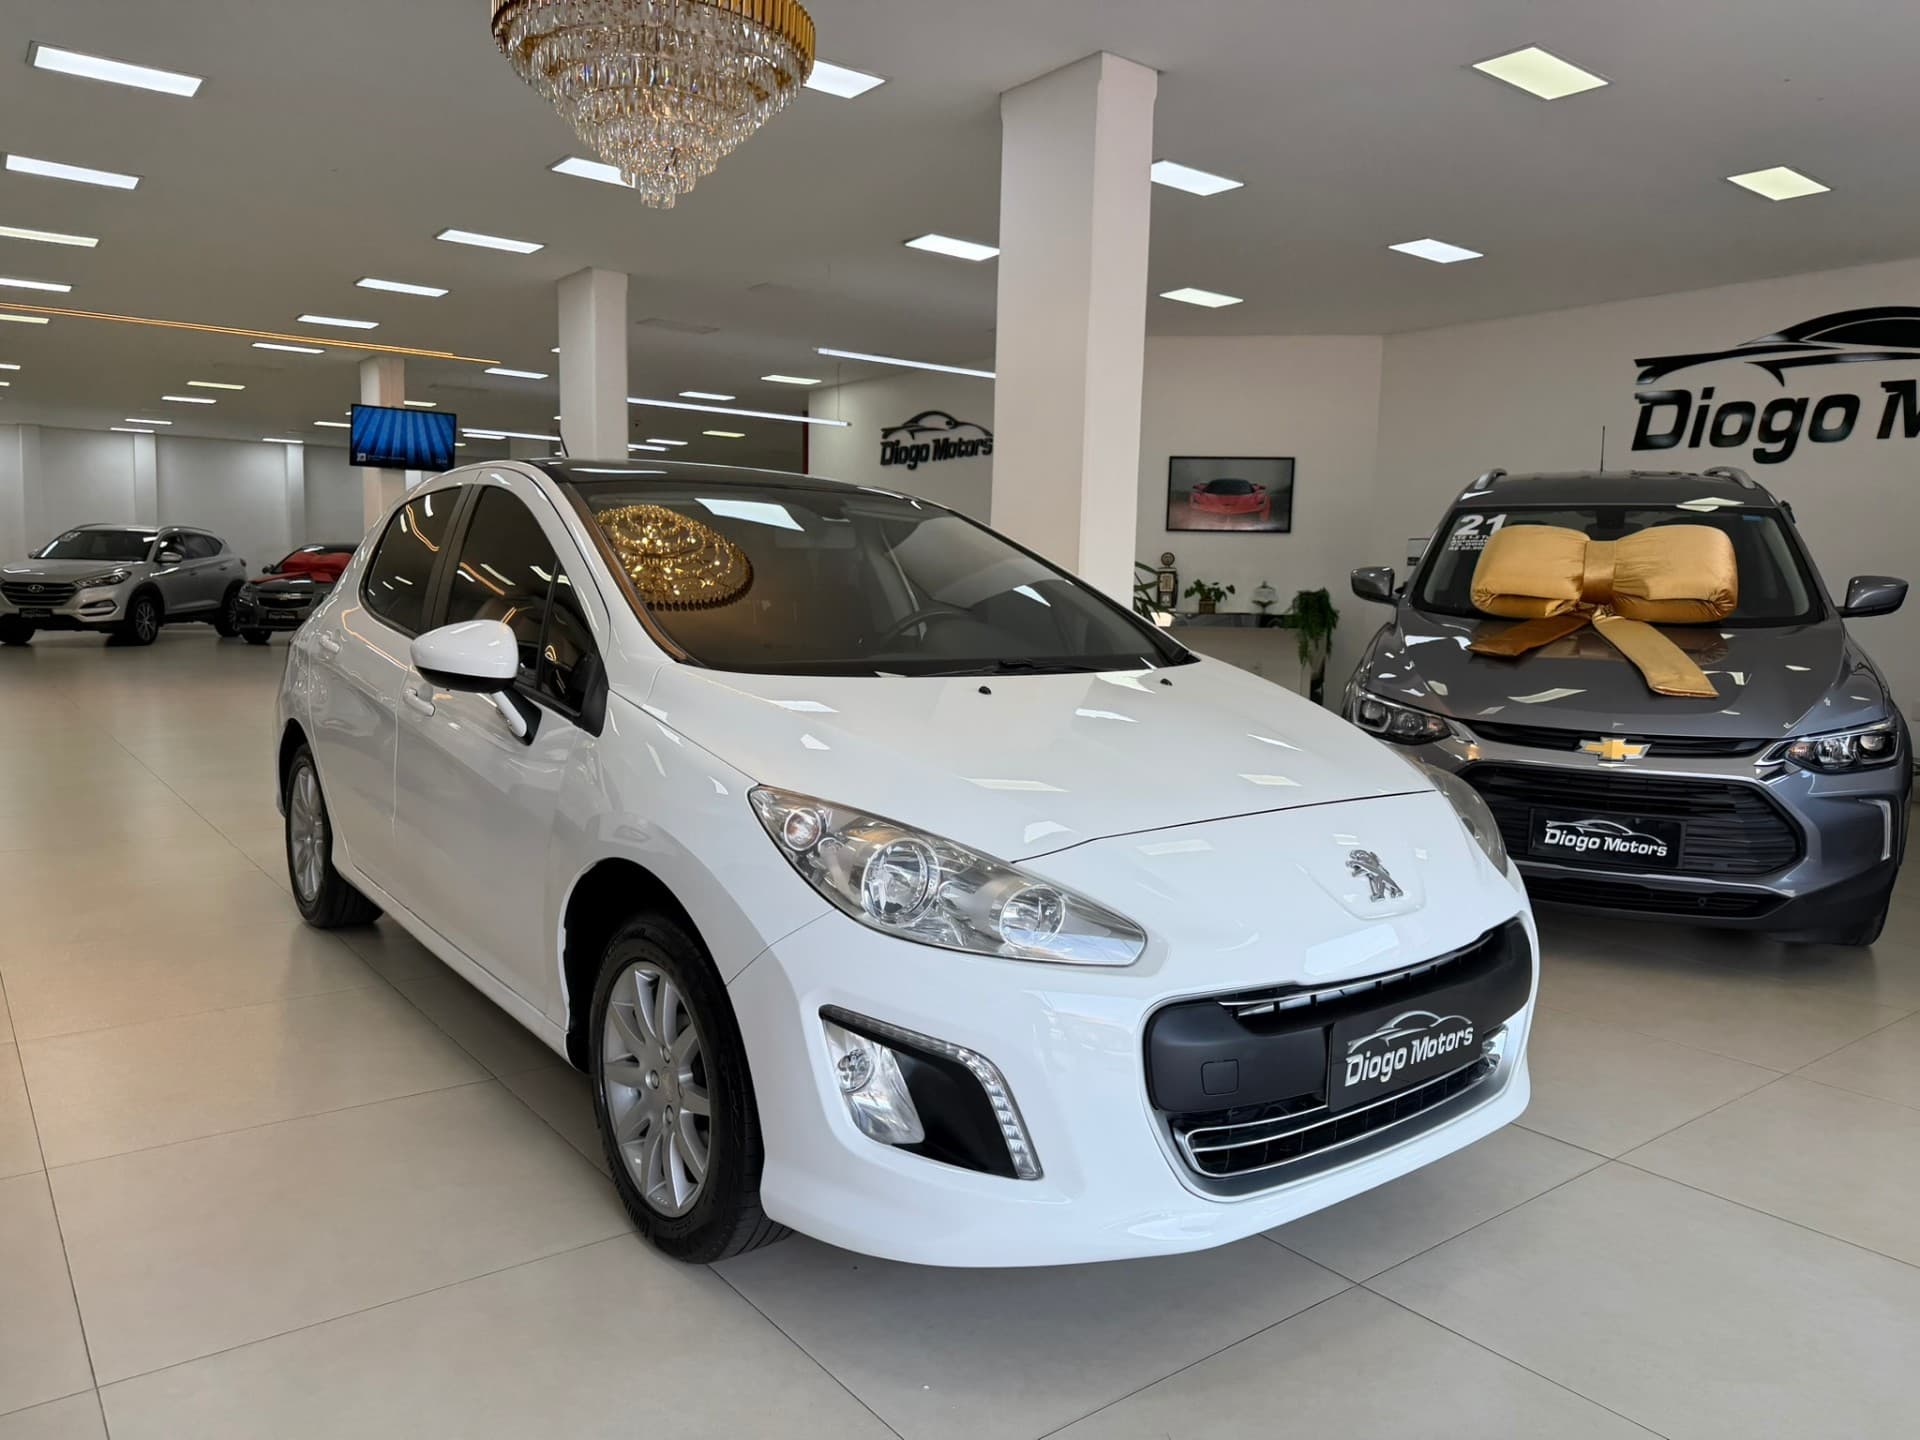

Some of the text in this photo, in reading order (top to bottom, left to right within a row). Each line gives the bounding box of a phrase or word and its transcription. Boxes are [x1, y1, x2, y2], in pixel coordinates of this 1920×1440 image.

[1631, 386, 1861, 465] Diogo
[880, 437, 993, 470] Diogo Motors
[1454, 513, 1508, 536] 21
[1544, 827, 1668, 857] Diogo Motors
[1344, 1026, 1474, 1088] Diogo Motors
